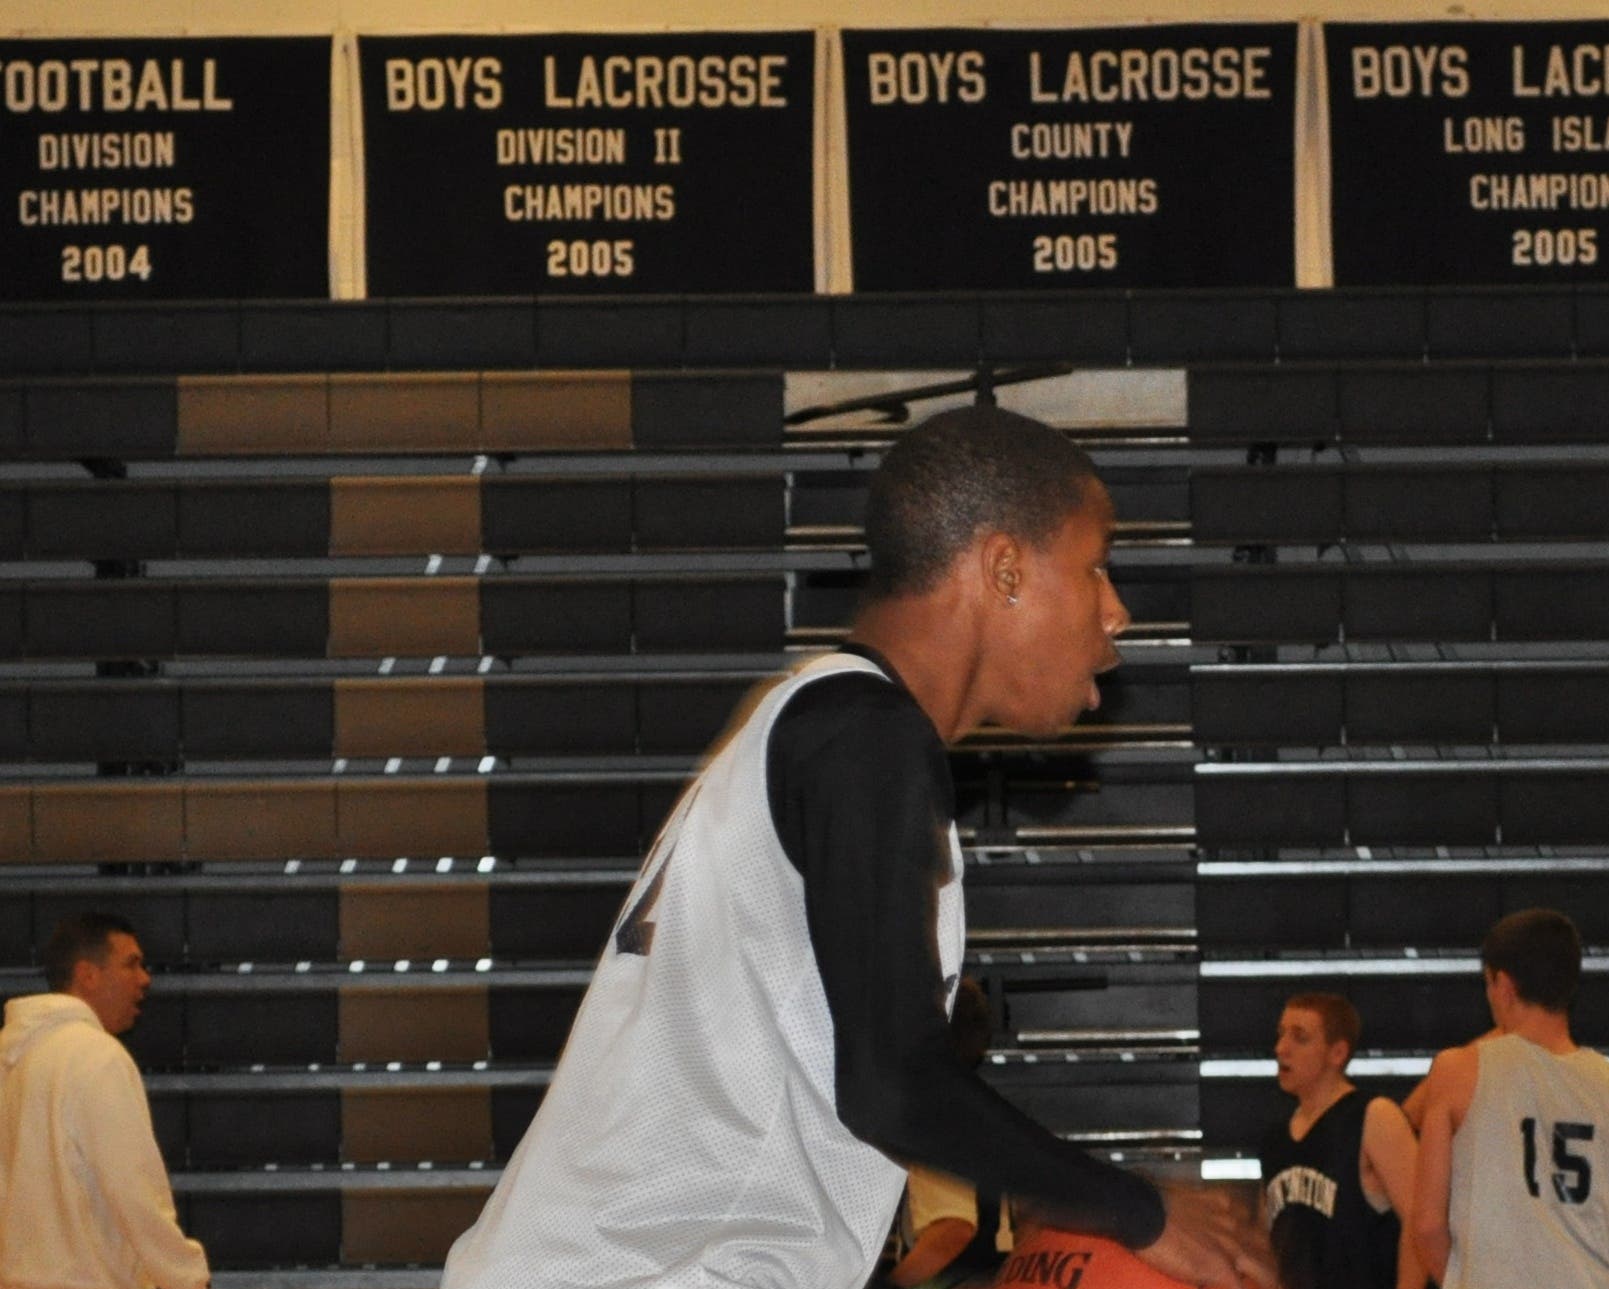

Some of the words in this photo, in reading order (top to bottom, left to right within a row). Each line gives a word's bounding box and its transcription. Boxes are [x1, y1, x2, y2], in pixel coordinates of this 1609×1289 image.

[0, 58, 233, 112] OOTBALL
[385, 57, 503, 111] BOYS
[544, 55, 787, 109] LACROSSE
[868, 50, 986, 105] BOYS
[1029, 47, 1271, 103] LACROSSE
[1352, 45, 1470, 98] BOYS
[39, 131, 175, 170] DIVISION
[496, 128, 625, 165] DIVISION
[654, 128, 681, 164] II
[1011, 122, 1133, 159] COUNTY
[1444, 116, 1525, 153] LONG
[19, 187, 194, 226] CHAMPIONS
[504, 184, 675, 221] CHAMPIONS
[988, 178, 1158, 217] CHAMPIONS
[62, 244, 152, 282] 2004
[547, 239, 634, 277] 2005
[1033, 233, 1117, 272] 2005
[1512, 228, 1598, 266] 2005
[1520, 1117, 1595, 1205] 15
